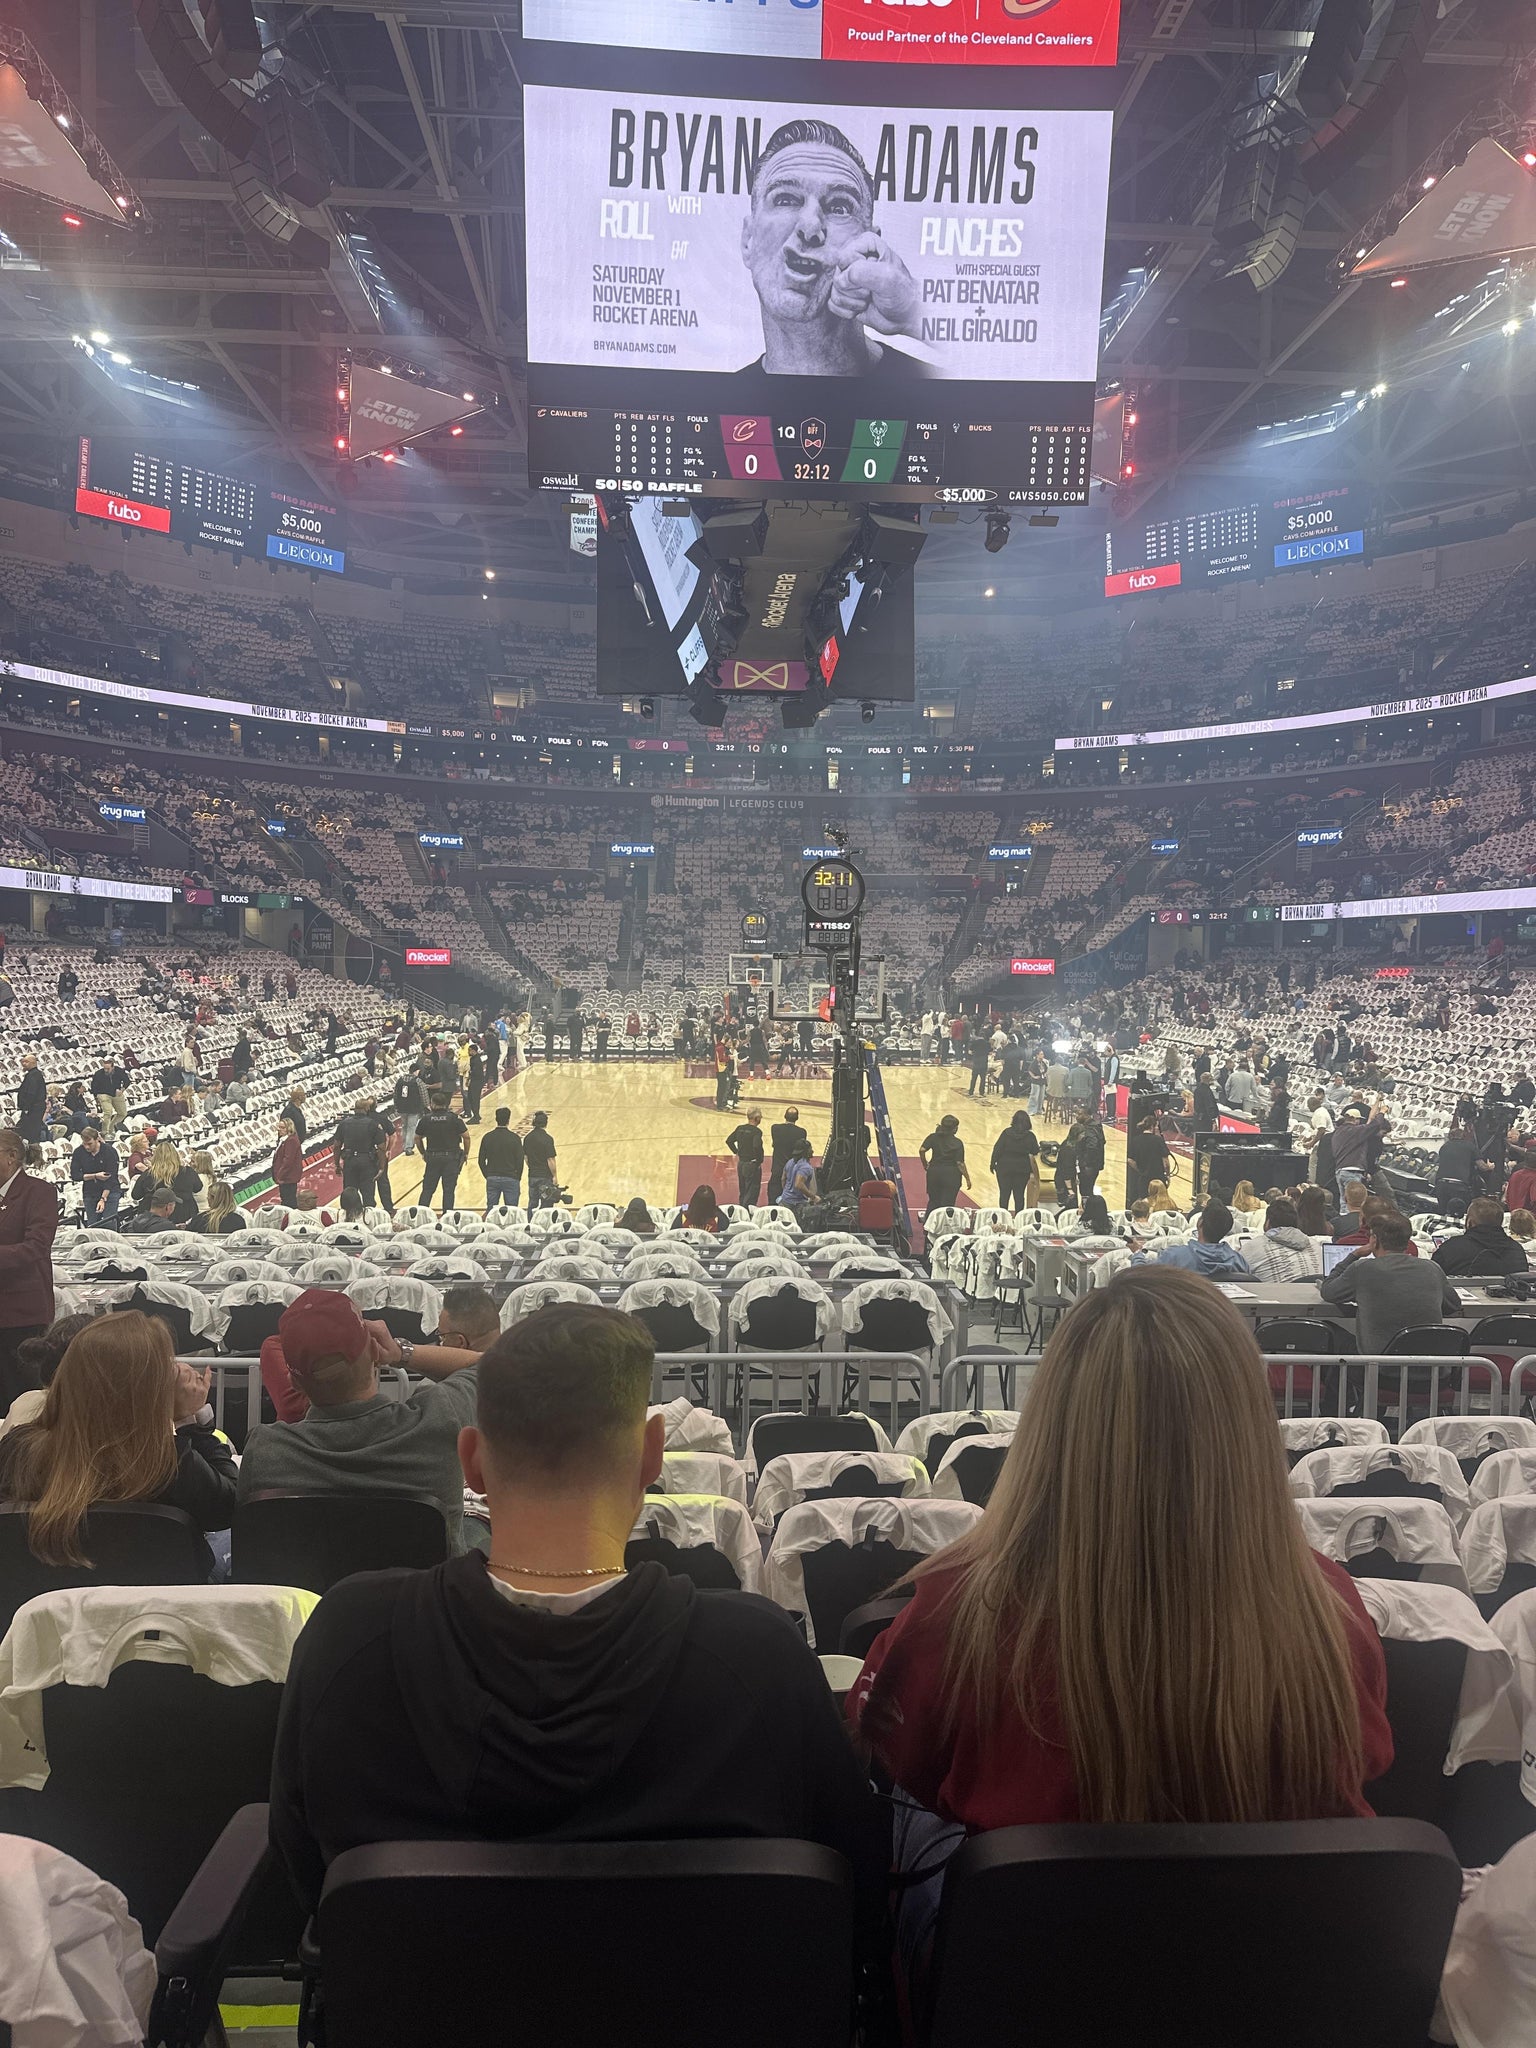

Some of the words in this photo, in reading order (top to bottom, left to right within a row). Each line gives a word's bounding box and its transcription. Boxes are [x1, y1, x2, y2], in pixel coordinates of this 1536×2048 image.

[848, 28, 884, 42] Proud
[887, 30, 931, 43] Partner
[934, 32, 946, 44] of
[950, 32, 968, 44] the
[971, 33, 1032, 45] Cleveland
[1036, 34, 1093, 46] Cavaliers
[609, 108, 761, 196] BRYAN
[874, 124, 1038, 205] ADAMS
[667, 194, 701, 216] WITH
[600, 198, 654, 241] ROLL
[920, 217, 1024, 257] PUNCHES
[593, 264, 664, 285] SATURDAY
[956, 264, 978, 276] WITH
[979, 264, 1012, 276] SPECIAL
[1014, 264, 1040, 277] GUEST
[593, 285, 672, 306] NOVEMBER
[676, 290, 681, 306] 1
[922, 279, 955, 303] PAT
[957, 280, 1039, 304] BENATAR
[593, 305, 648, 325] ROCKET
[650, 309, 698, 328] ARENA
[922, 318, 959, 342] NEIL
[962, 319, 1038, 342] GIRALDO
[594, 340, 676, 354] BRYANADAMS.COM
[550, 410, 588, 418] CAVALIERS
[694, 424, 700, 432] 0
[778, 426, 795, 439] 1Q
[745, 454, 758, 474] 0
[864, 459, 876, 478] 0
[794, 464, 830, 480] 32:12
[542, 474, 578, 486] oswald
[648, 482, 702, 493] RAFFLE
[943, 488, 986, 502] $5,000
[1009, 492, 1085, 500] CAVS5050.COM
[107, 501, 141, 522] fubo
[282, 512, 322, 533] $5,000
[573, 517, 597, 526] CONFERE
[1288, 510, 1333, 531] $5,000
[203, 521, 231, 533] WELCOME
[233, 527, 242, 535] TO
[200, 532, 222, 543] ROCKET
[223, 536, 244, 547] ARENA!
[1210, 555, 1238, 565] WELCOME
[1208, 568, 1230, 576] ROCKET
[1230, 564, 1251, 572] ARENA!
[1129, 573, 1156, 589] fubo
[1370, 701, 1406, 717] NOVEMBER
[1416, 698, 1432, 710] 2025
[1440, 692, 1466, 706] ROCKET
[1467, 687, 1488, 701] ARENA
[252, 705, 286, 719] NOVEMBER
[296, 711, 312, 722] 2025
[318, 713, 344, 726] ROCKET
[346, 717, 368, 728] ARENA
[1074, 737, 1094, 748] BRYAN
[1096, 736, 1118, 746] ADAMS
[665, 795, 719, 809] Huntington
[729, 800, 774, 809] LEGENDS
[100, 804, 122, 817] drug
[123, 808, 145, 818] mart
[268, 824, 282, 832] drug
[419, 834, 441, 845] drug
[442, 836, 463, 846] mart
[1298, 831, 1319, 843] drug
[611, 844, 633, 854] drug
[633, 845, 654, 853] mart
[989, 846, 1009, 858] drug
[1011, 847, 1031, 856] mart
[26, 872, 42, 888] BRYAN
[44, 874, 60, 891] ADAMS
[814, 872, 852, 886] 32:11
[221, 895, 249, 903] BLOCKS
[1252, 911, 1257, 919] 0
[1285, 907, 1303, 919] BRYAN
[1305, 906, 1324, 918] ADAMS
[417, 952, 448, 962] Rocket
[1109, 952, 1123, 960] Full
[1022, 963, 1052, 972] Rocket
[1114, 962, 1137, 970] Power
